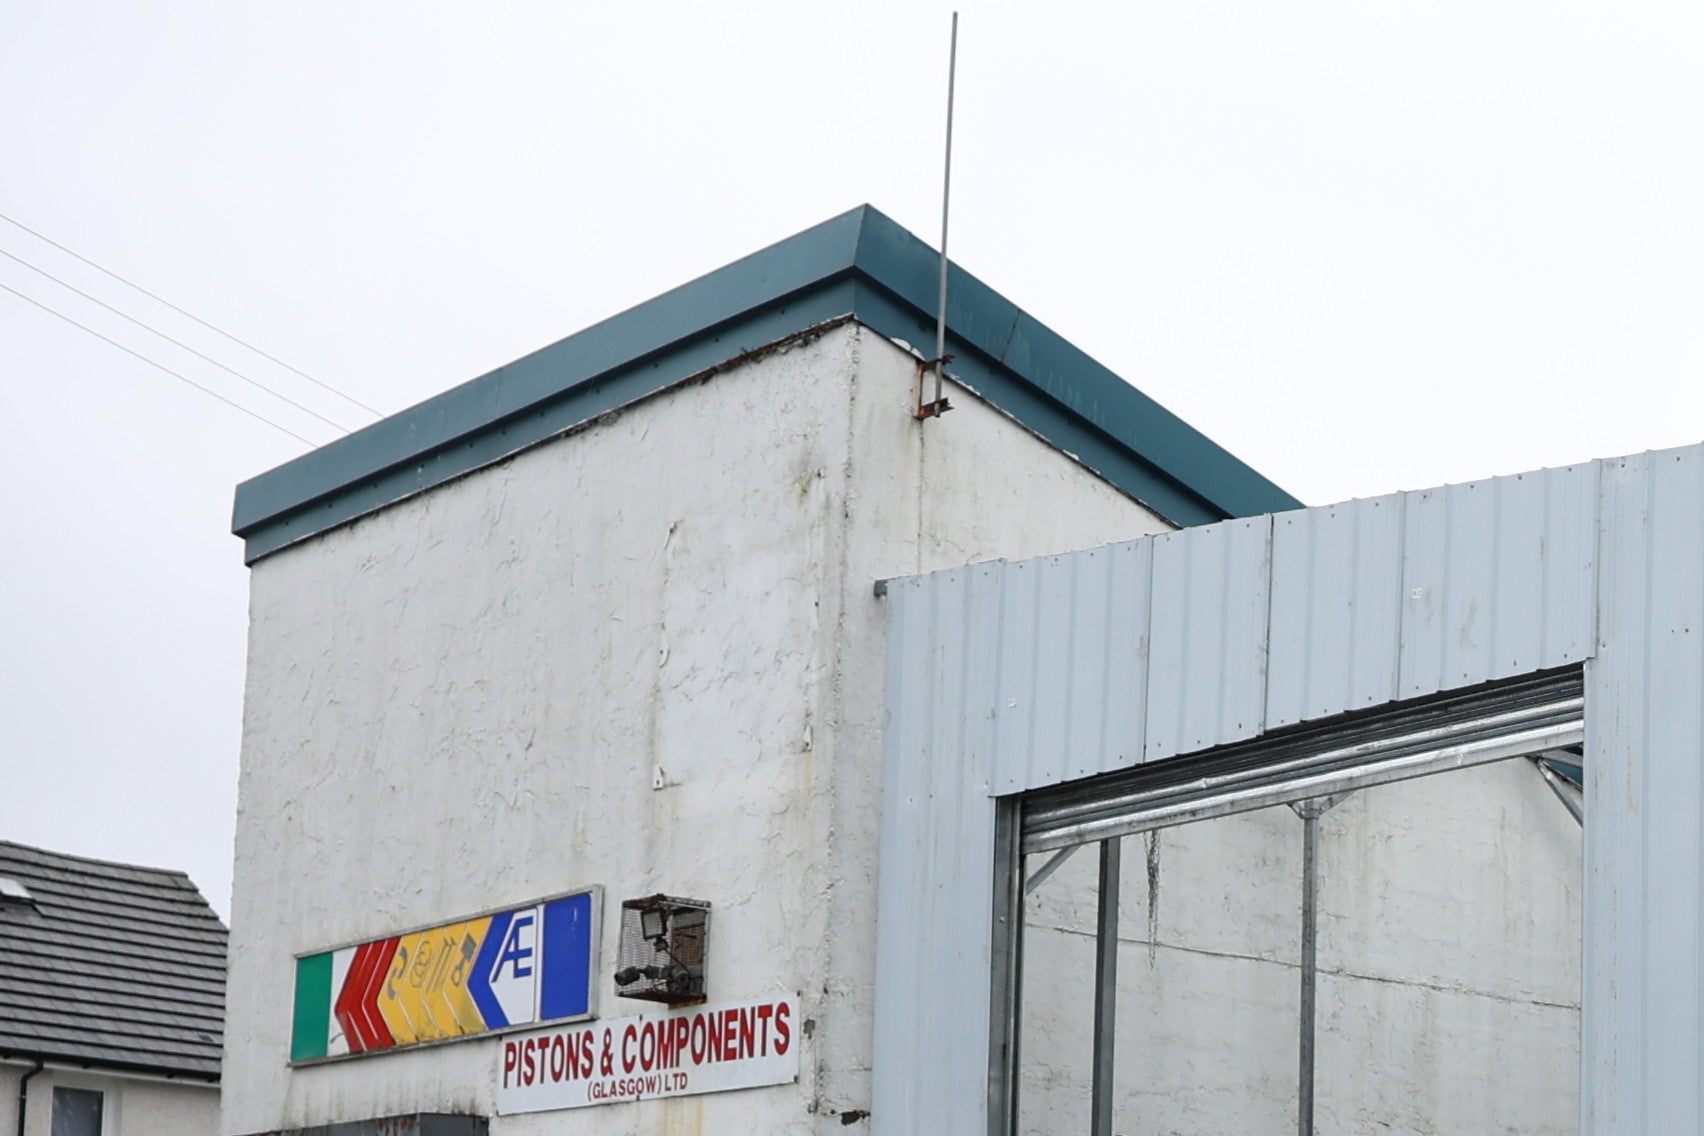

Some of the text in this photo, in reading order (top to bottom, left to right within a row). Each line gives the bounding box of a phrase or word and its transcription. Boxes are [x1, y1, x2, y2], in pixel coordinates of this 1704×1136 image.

[503, 1001, 790, 1089] PISTONS & COMPONENTS
[587, 1072, 688, 1102] (GLASGOW) LTD
